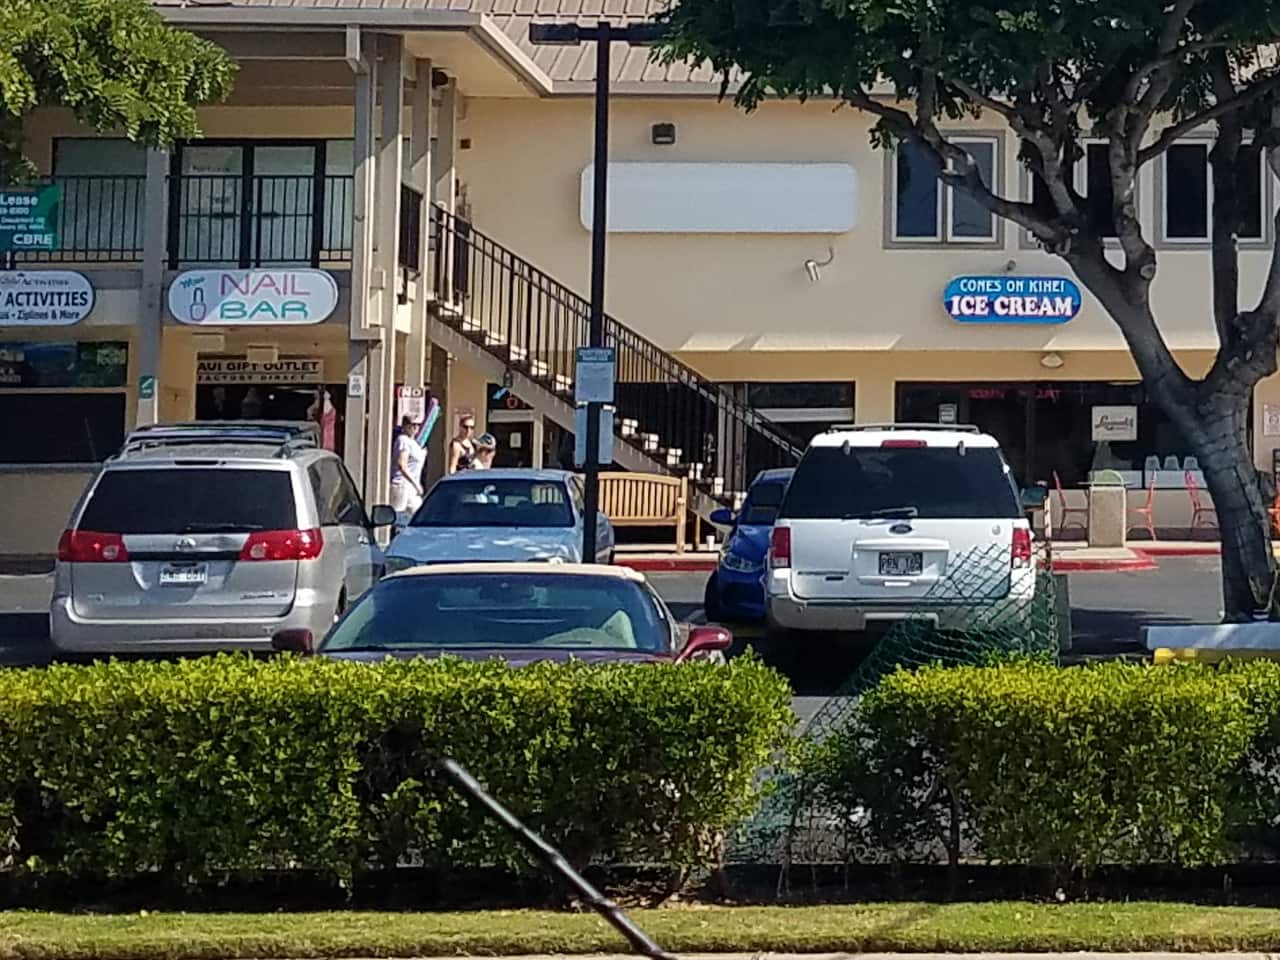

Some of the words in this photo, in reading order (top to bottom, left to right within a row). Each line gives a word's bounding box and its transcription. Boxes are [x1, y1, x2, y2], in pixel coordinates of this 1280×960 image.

[13, 234, 54, 245] CBRE
[220, 273, 311, 296] NAIL
[960, 279, 1002, 292] CONES
[1006, 280, 1024, 292] ON
[1029, 280, 1065, 292] KIHEI
[4, 291, 89, 307] ACTIVITIES
[951, 296, 989, 315] ICE
[994, 296, 1073, 316] CREAM
[220, 300, 309, 319] BAR
[263, 362, 319, 371] OUTLET
[401, 386, 422, 397] NO
